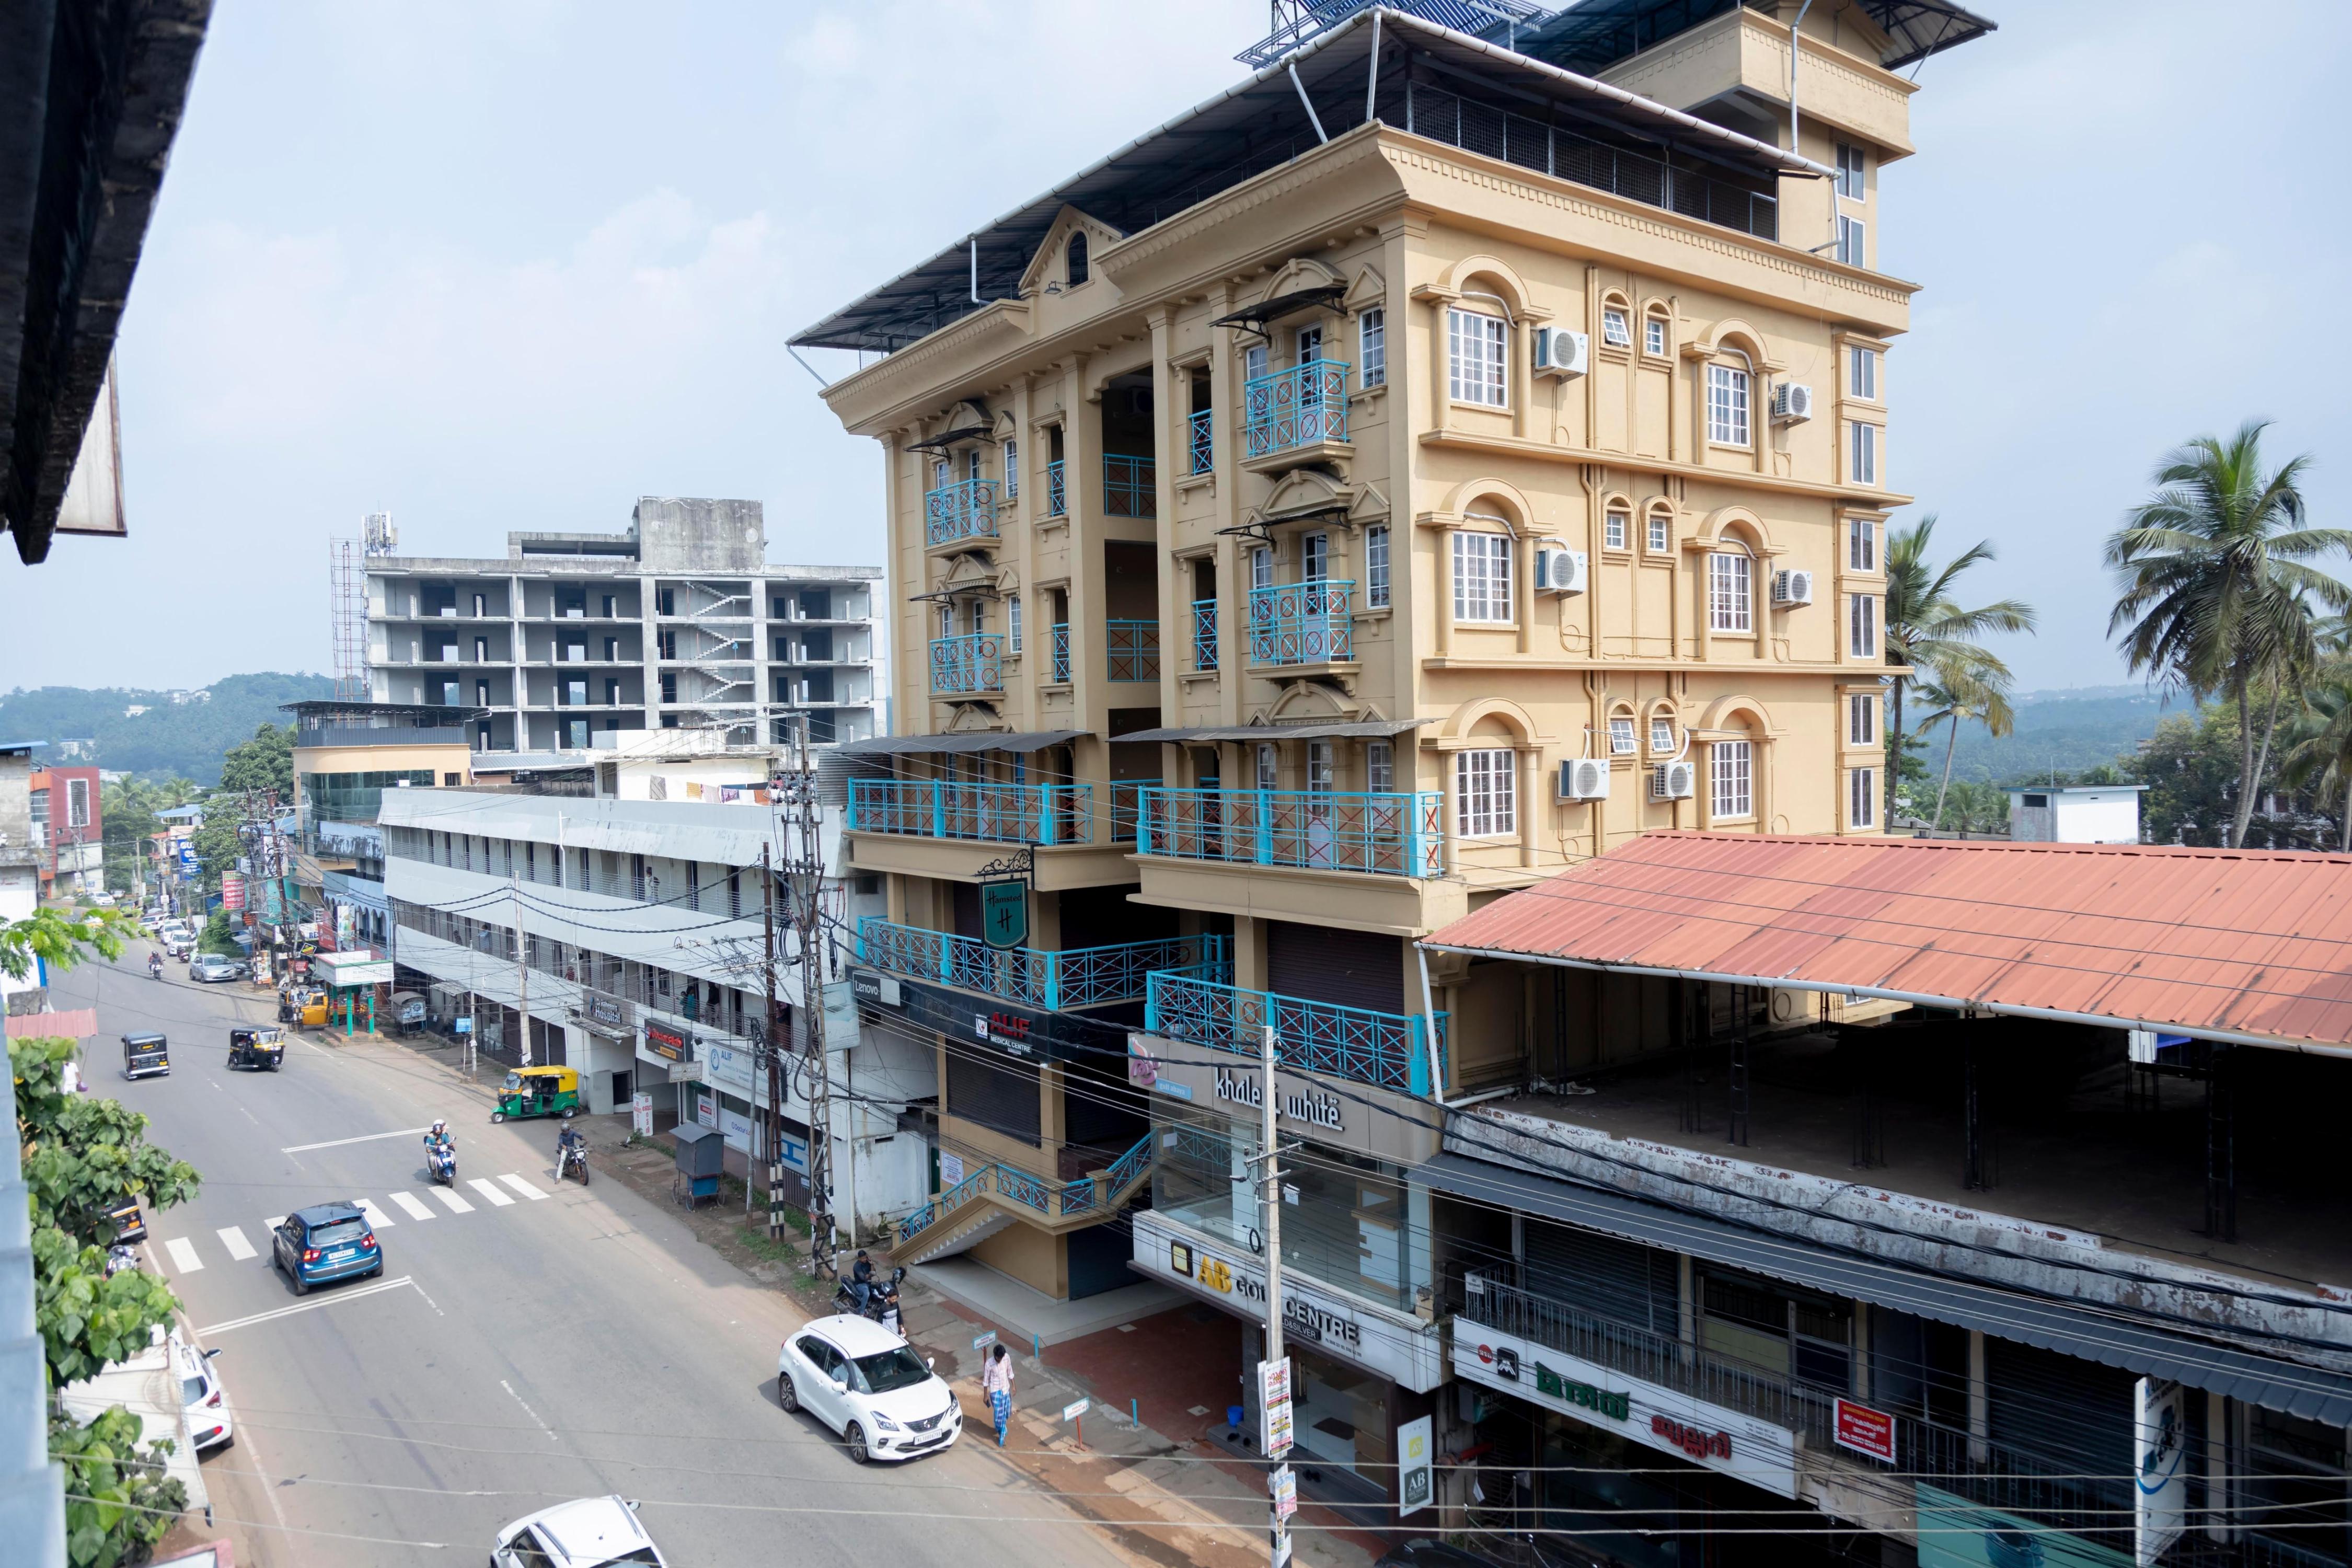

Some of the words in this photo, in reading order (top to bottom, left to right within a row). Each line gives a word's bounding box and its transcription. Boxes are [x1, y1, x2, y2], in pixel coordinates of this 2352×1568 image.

[986, 891, 1022, 907] Hamsted
[855, 980, 878, 995] Lenovo
[595, 1006, 621, 1024] Hospital
[990, 1012, 1031, 1039] ALIF
[990, 1035, 1011, 1047] MEDICAL
[1011, 1042, 1031, 1053] CENTRE
[721, 1050, 732, 1061] ALIF
[1197, 1254, 1232, 1293] AB
[1286, 1296, 1359, 1345] CENTRE
[1409, 1472, 1425, 1491] AB
